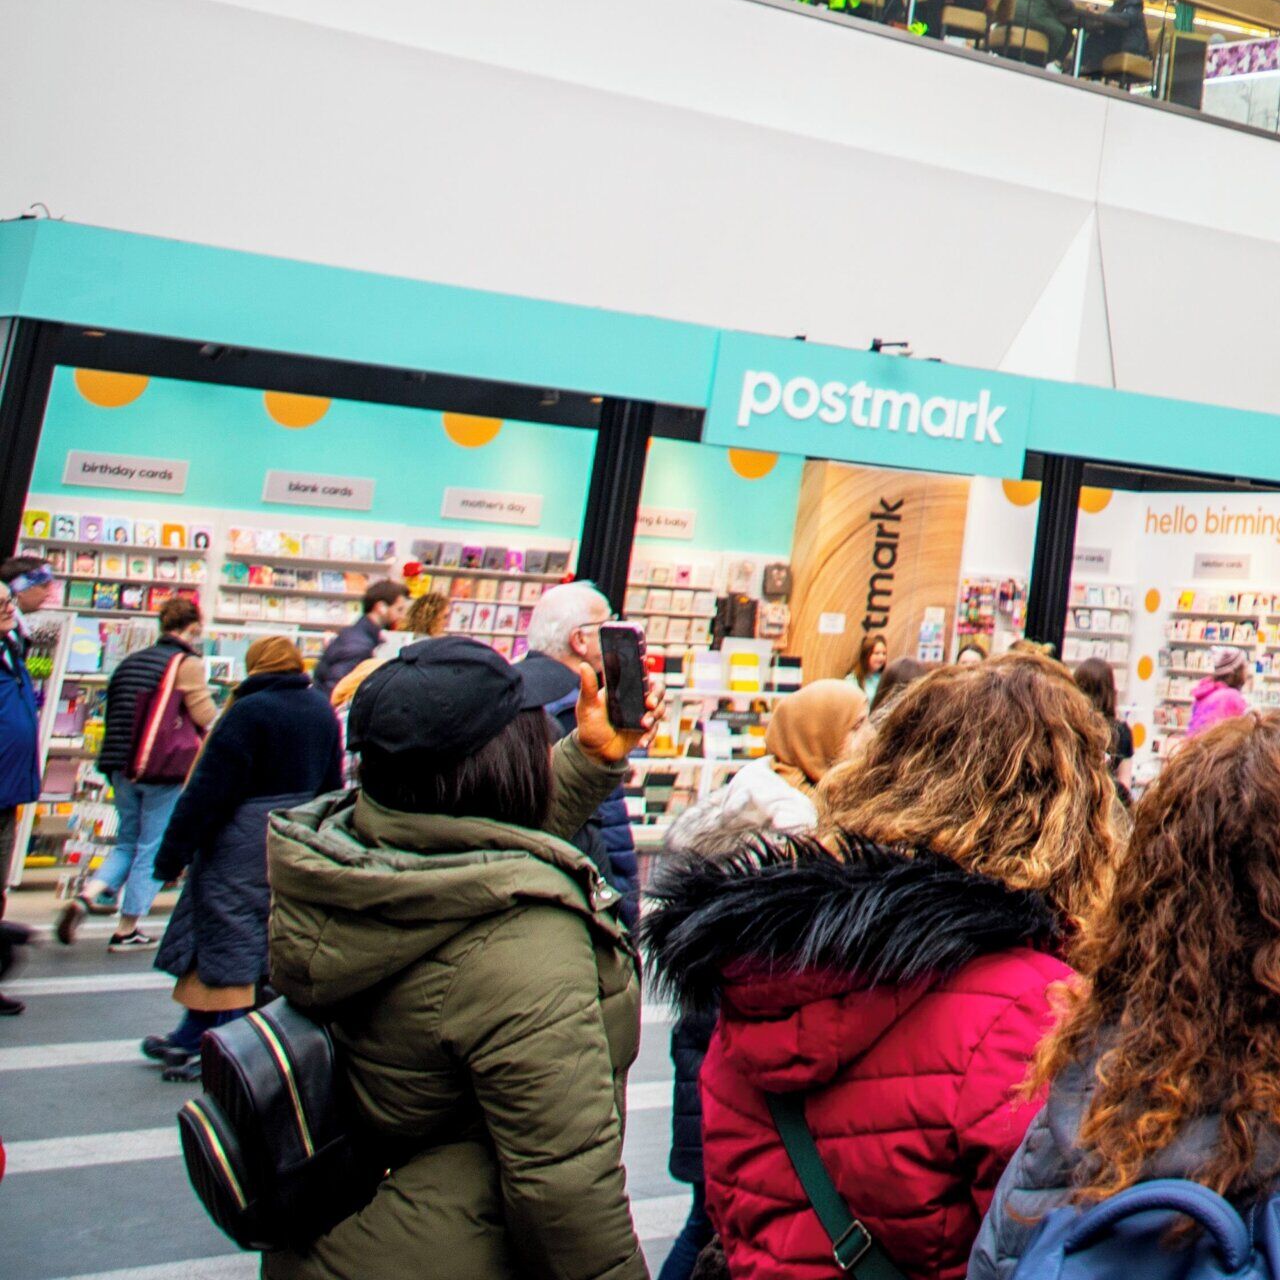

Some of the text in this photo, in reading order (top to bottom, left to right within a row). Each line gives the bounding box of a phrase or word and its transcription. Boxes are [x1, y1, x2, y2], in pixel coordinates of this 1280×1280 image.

[737, 369, 1007, 445] postmark
[81, 461, 173, 482] birthday cards
[287, 480, 354, 498] blank cards
[460, 496, 528, 516] mother's day
[1144, 507, 1198, 534] hello
[861, 497, 905, 636] tmark
